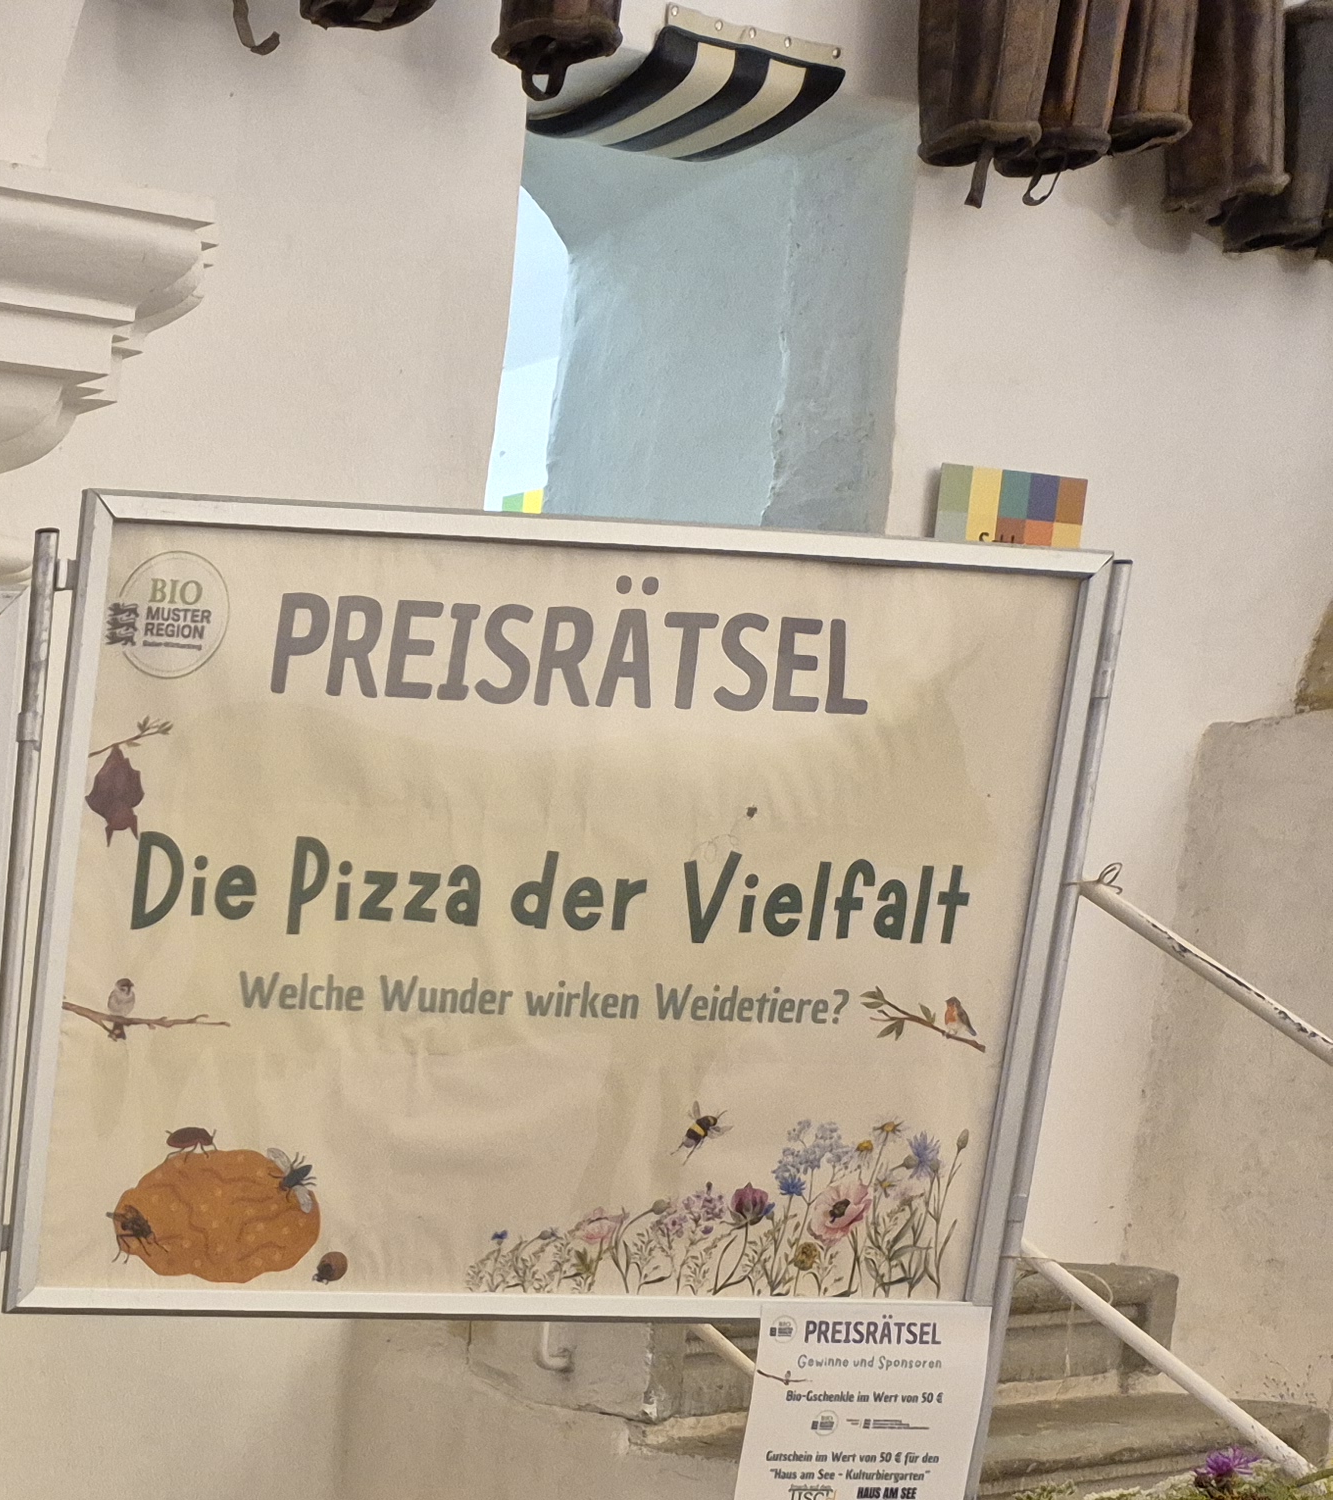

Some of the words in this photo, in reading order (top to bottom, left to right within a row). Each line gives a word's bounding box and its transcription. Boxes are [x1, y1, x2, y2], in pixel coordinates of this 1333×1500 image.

[147, 577, 204, 606] BIO
[145, 605, 212, 624] MUSTER
[143, 621, 206, 640] REGION
[269, 574, 870, 717] PREISRÄTSEL
[130, 829, 258, 931] Die
[287, 834, 483, 936] Pizza
[509, 848, 648, 933] der
[683, 850, 970, 945] Vielfalt
[237, 969, 364, 1014] Welche
[379, 973, 510, 1019] Wunder
[525, 977, 641, 1023] wirken
[654, 982, 850, 1028] Weidetiere?
[803, 1313, 942, 1345] PREISRÄTSEL
[797, 1353, 849, 1369] Gewinne
[852, 1355, 875, 1369] und
[877, 1354, 942, 1372] Sponsoren
[856, 1486, 881, 1500] HAUS
[882, 1486, 900, 1500] AM
[900, 1486, 918, 1500] SEE
